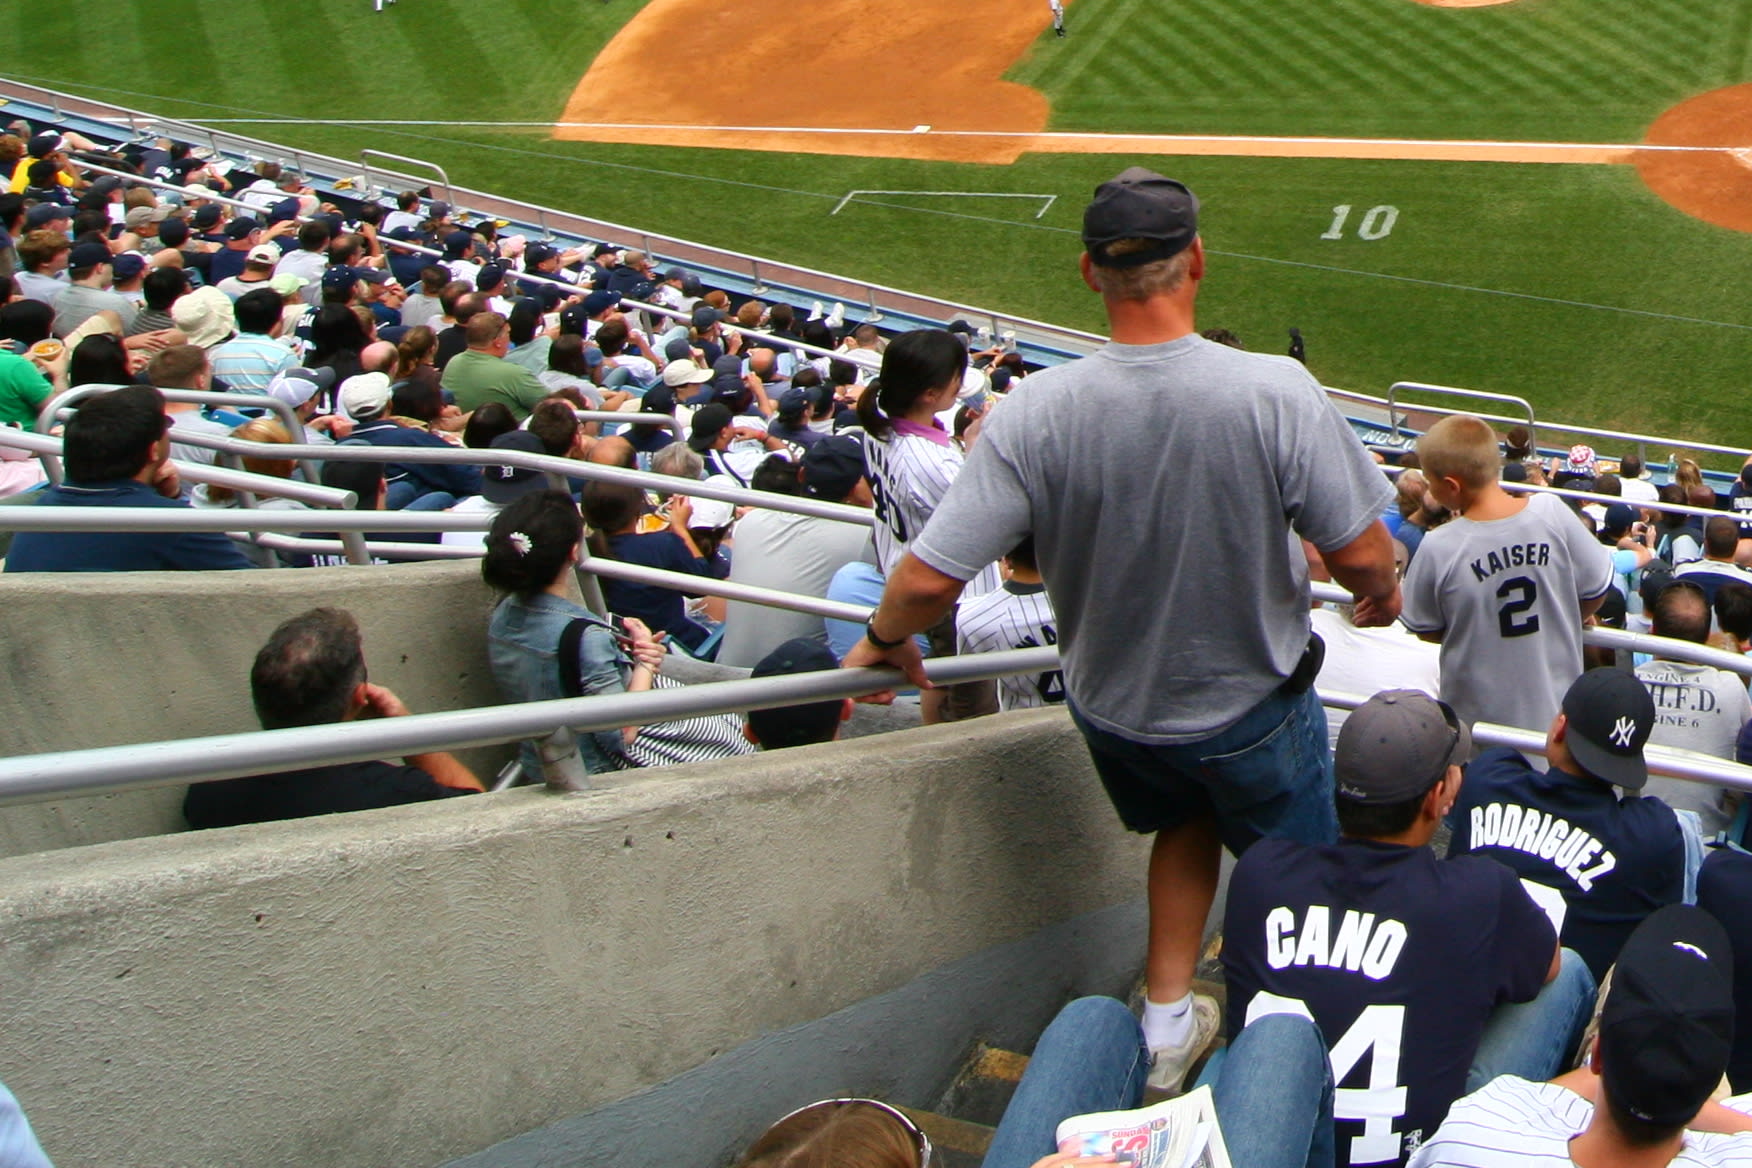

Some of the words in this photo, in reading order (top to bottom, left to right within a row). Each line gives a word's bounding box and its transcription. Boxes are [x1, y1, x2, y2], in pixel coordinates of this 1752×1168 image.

[1320, 204, 1400, 240] 10
[1469, 541, 1551, 583] KAISER
[1496, 576, 1541, 639] 2
[1691, 719, 1700, 729] 6
[1470, 802, 1617, 893] RODRIGUEZ
[1265, 905, 1409, 981] CANO
[1245, 990, 1408, 1165] 4
